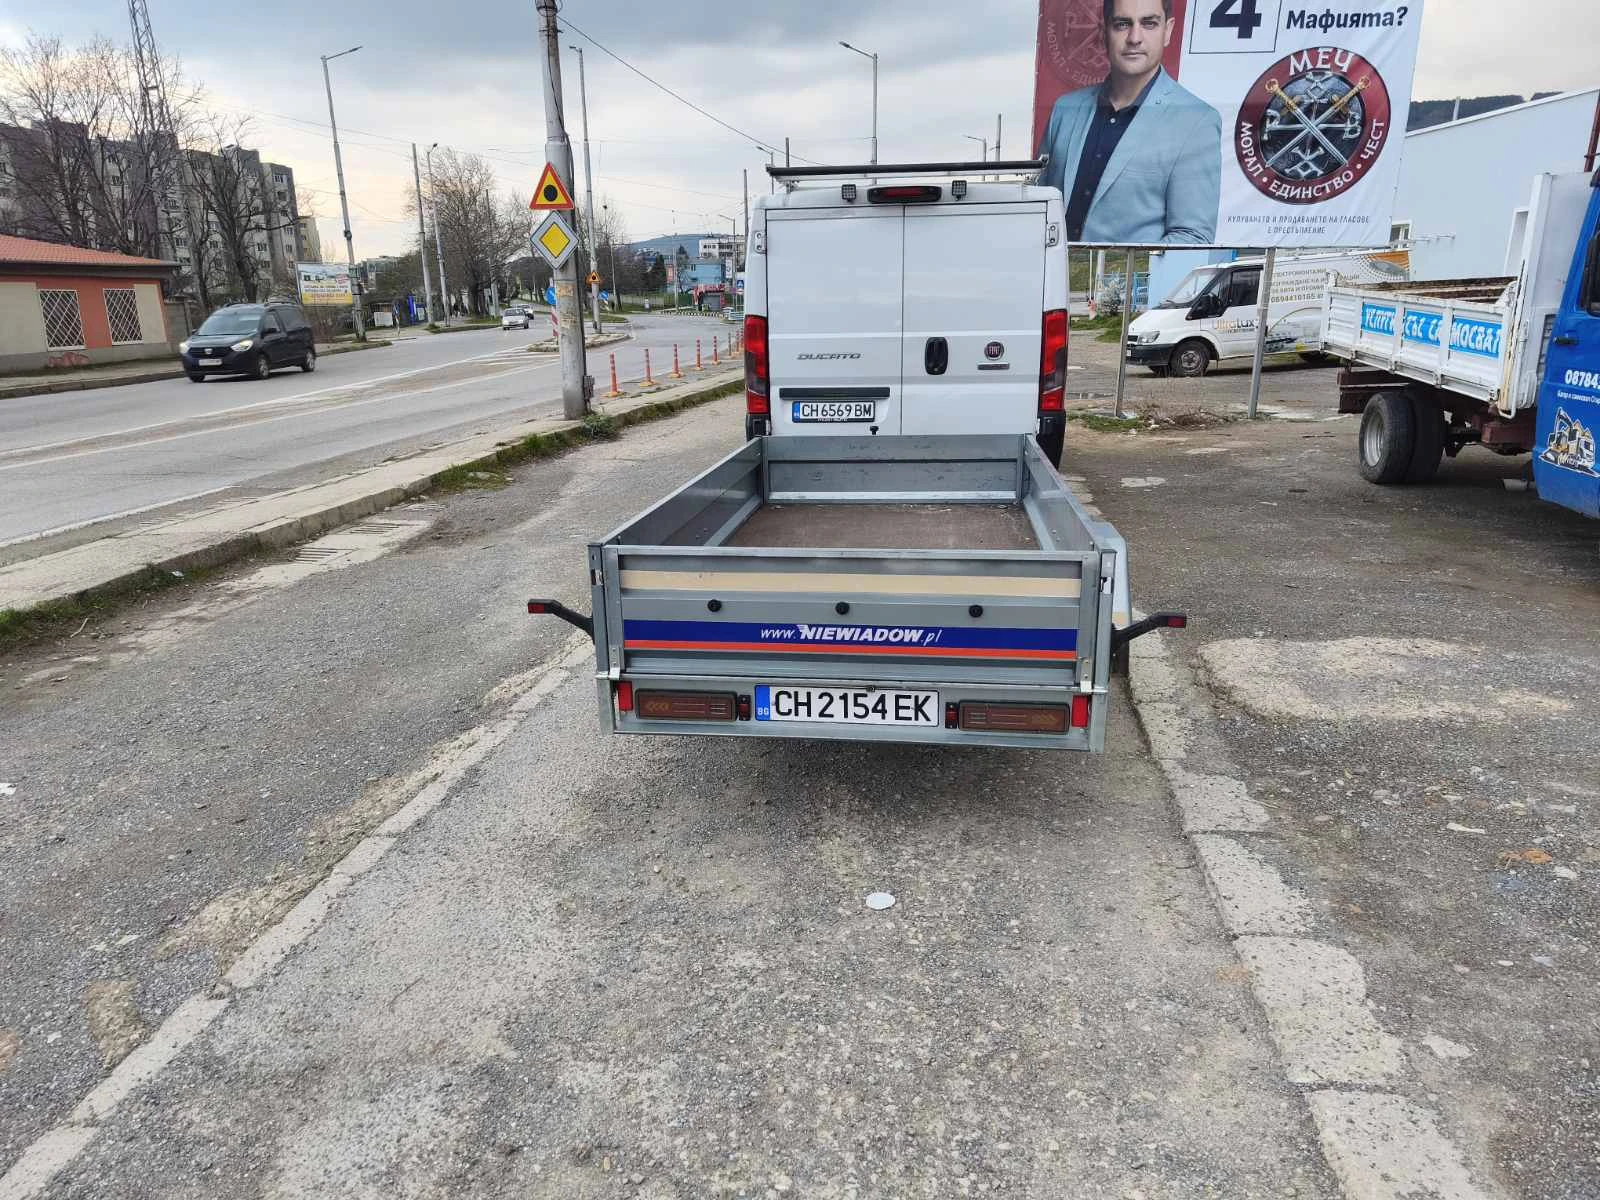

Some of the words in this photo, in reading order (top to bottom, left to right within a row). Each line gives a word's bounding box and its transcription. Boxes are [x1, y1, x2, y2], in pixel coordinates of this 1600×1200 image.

[1209, 0, 1262, 39] 4
[1286, 6, 1408, 34] Мафията?
[1289, 47, 1354, 76] МЕЧ
[1240, 121, 1263, 177] МОРАЛ
[1268, 169, 1354, 199] ЕДИНСТВО
[1360, 118, 1385, 160] ЧЕСТ
[1564, 369, 1600, 389] 08784
[802, 404, 819, 417] CH
[821, 404, 852, 417] 6569
[854, 404, 872, 417] BM
[774, 690, 812, 718] CH
[818, 692, 887, 720] 2154
[895, 695, 931, 722] EK
